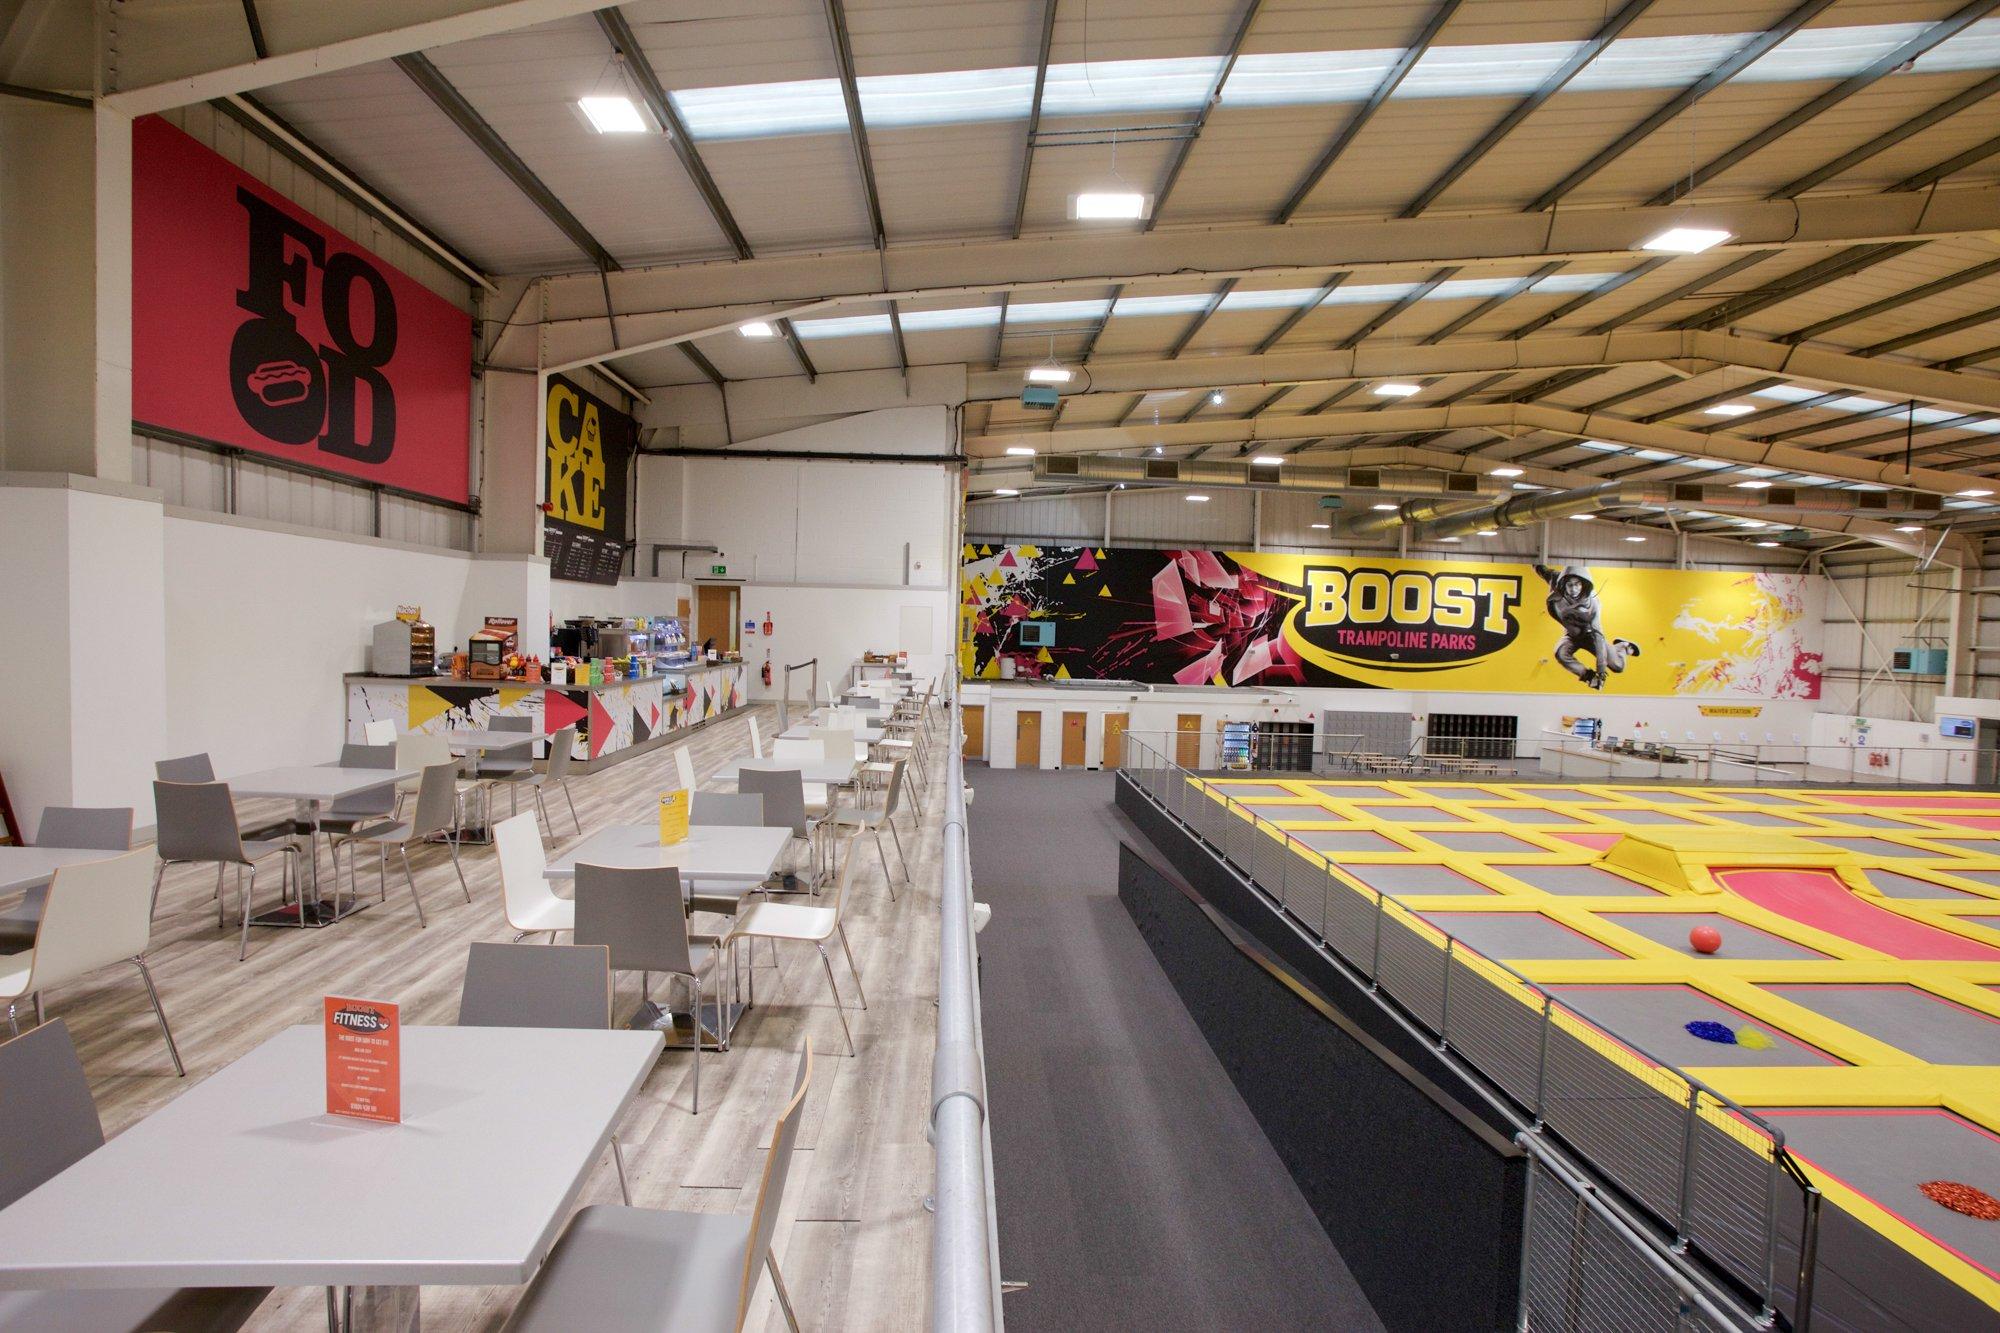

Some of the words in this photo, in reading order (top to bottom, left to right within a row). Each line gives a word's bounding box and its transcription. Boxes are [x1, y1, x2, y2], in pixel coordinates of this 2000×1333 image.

[1304, 569, 1518, 635] BOOST
[1337, 629, 1428, 648] TRAMPOLINE
[1431, 633, 1476, 650] PARKS
[333, 1011, 378, 1029] FITNESS
